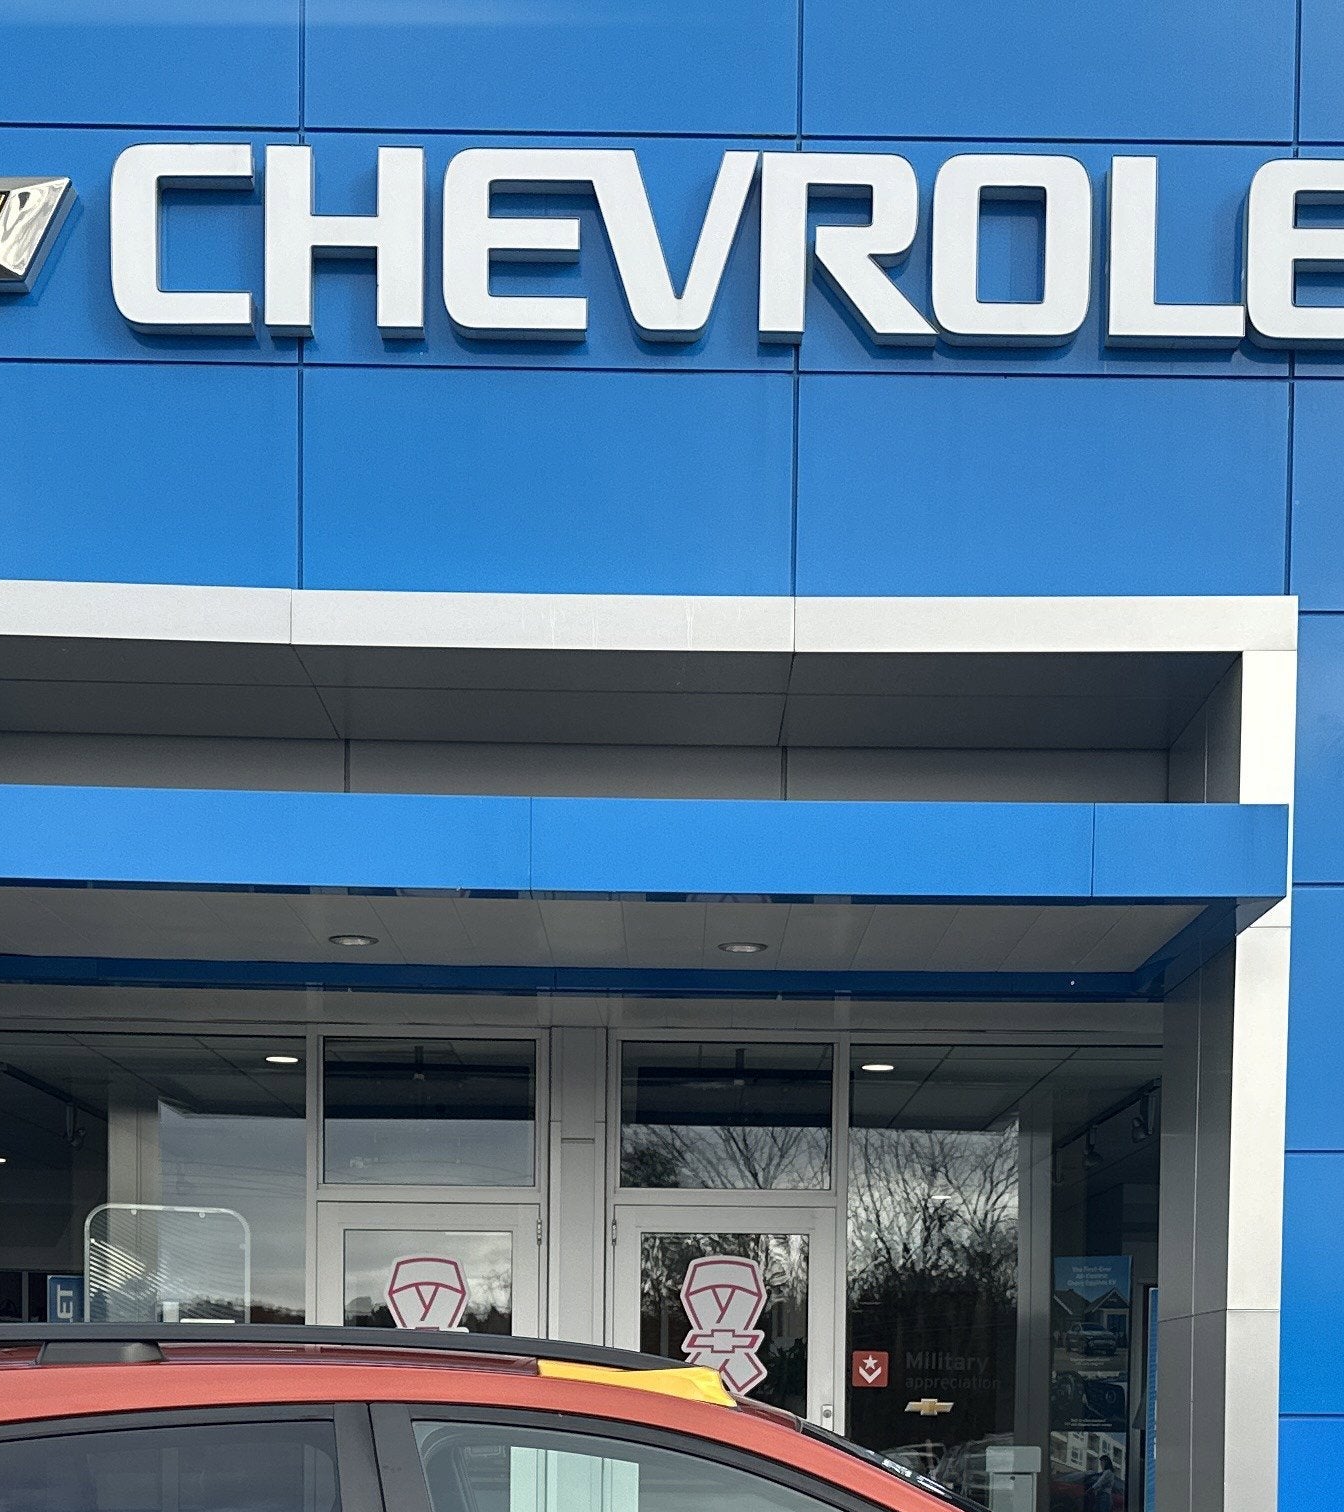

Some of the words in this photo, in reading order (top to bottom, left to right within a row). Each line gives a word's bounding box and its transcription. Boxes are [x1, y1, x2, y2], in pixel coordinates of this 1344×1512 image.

[57, 1284, 74, 1323] ET
[905, 1351, 990, 1373] Military
[905, 1375, 1001, 1390] appreciation
